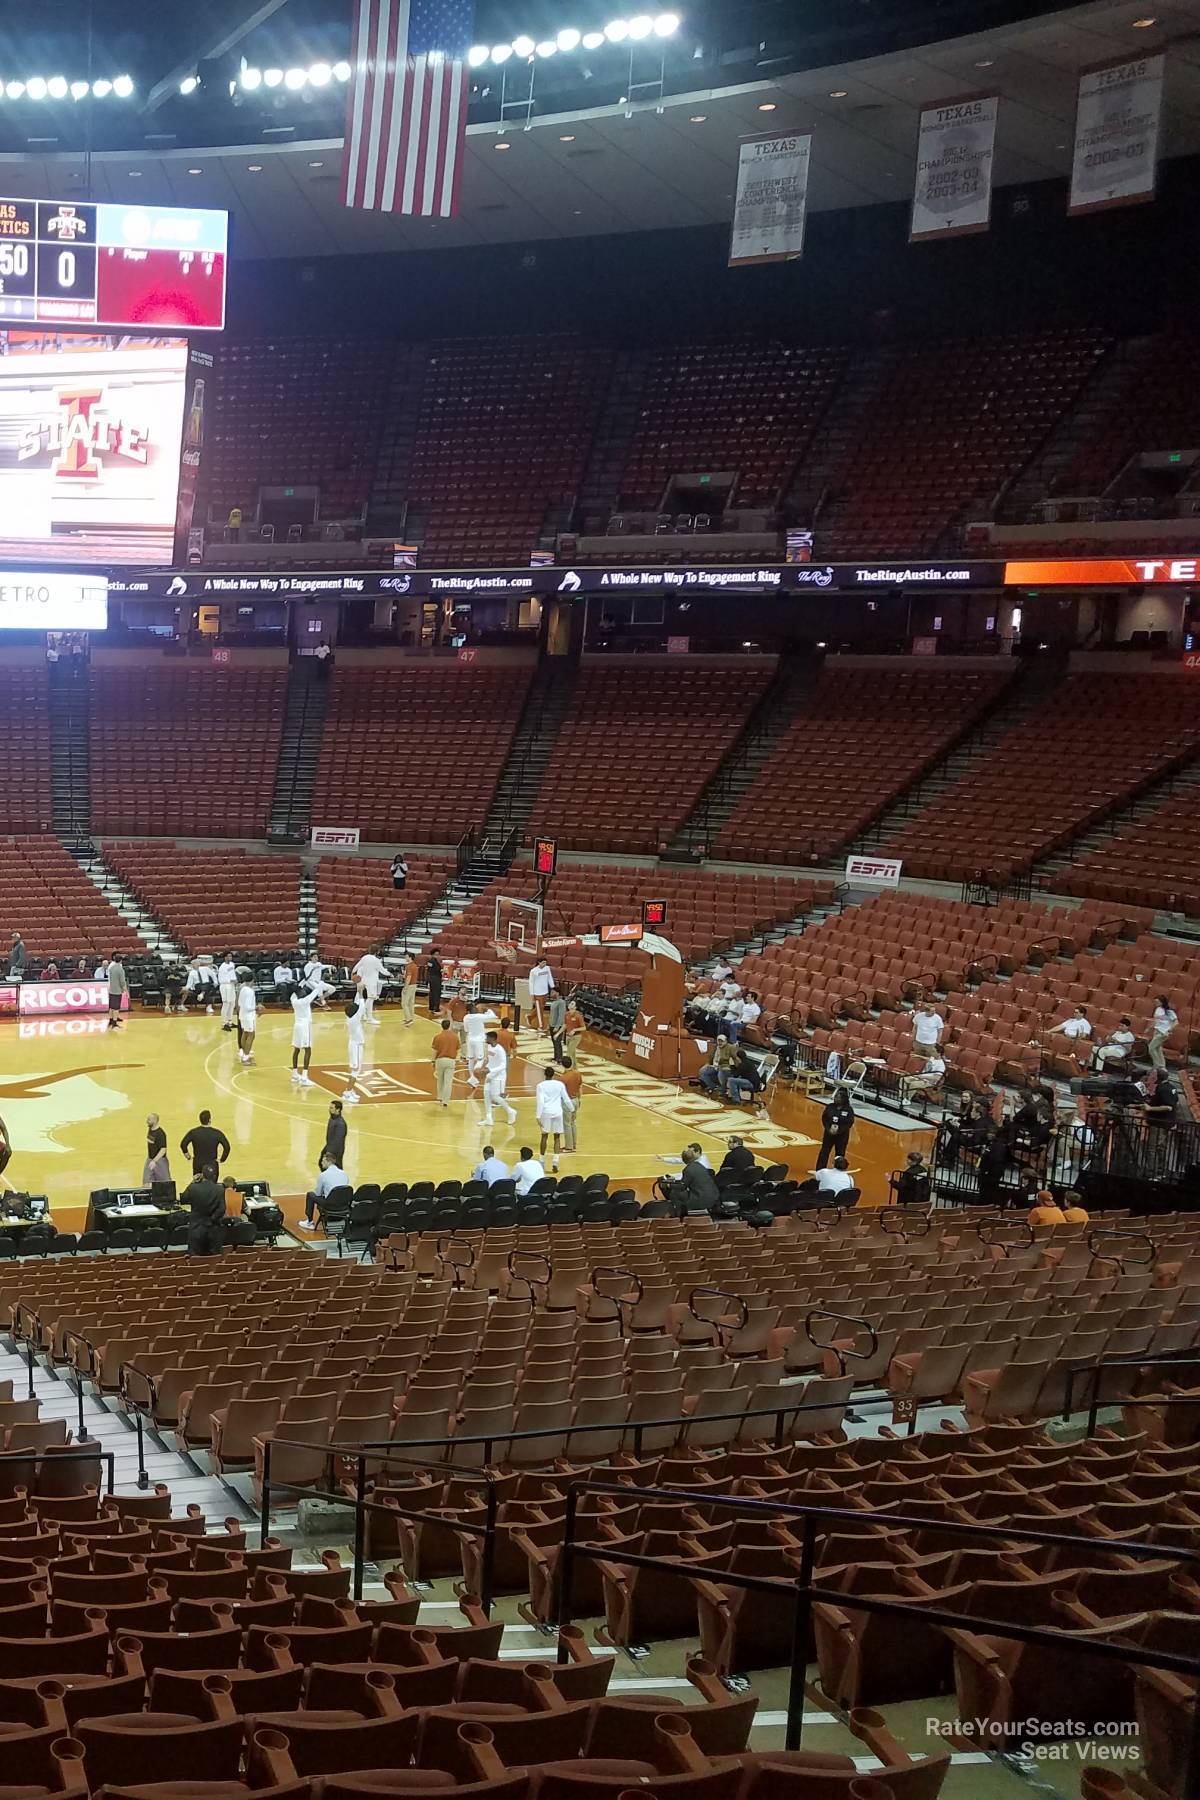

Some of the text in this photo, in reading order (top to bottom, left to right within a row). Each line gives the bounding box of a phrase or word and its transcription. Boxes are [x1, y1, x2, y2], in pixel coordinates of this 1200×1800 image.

[1098, 62, 1145, 85] TEXAS
[937, 103, 982, 121] TEXAS
[755, 139, 796, 155] TEXAS
[919, 149, 992, 171] CHAMPIONSHIPS
[58, 251, 76, 287] 0
[18, 413, 150, 465] STATE
[601, 570, 781, 585] A Whole New Way To Engagement Ring
[856, 569, 970, 582] TheRingAustin.com
[1135, 561, 1197, 580] TE
[106, 580, 149, 592] stin.com
[205, 578, 364, 592] A Whole New Way To Engagement Ring
[431, 577, 532, 590] TheRingAustin.com
[214, 650, 229, 661] 48
[460, 651, 476, 661] 47
[315, 832, 356, 843] ESPN
[851, 861, 897, 877] ESPN
[20, 987, 109, 1008] RICOH
[632, 1032, 656, 1050] MUSCLE
[898, 1400, 913, 1411] 35
